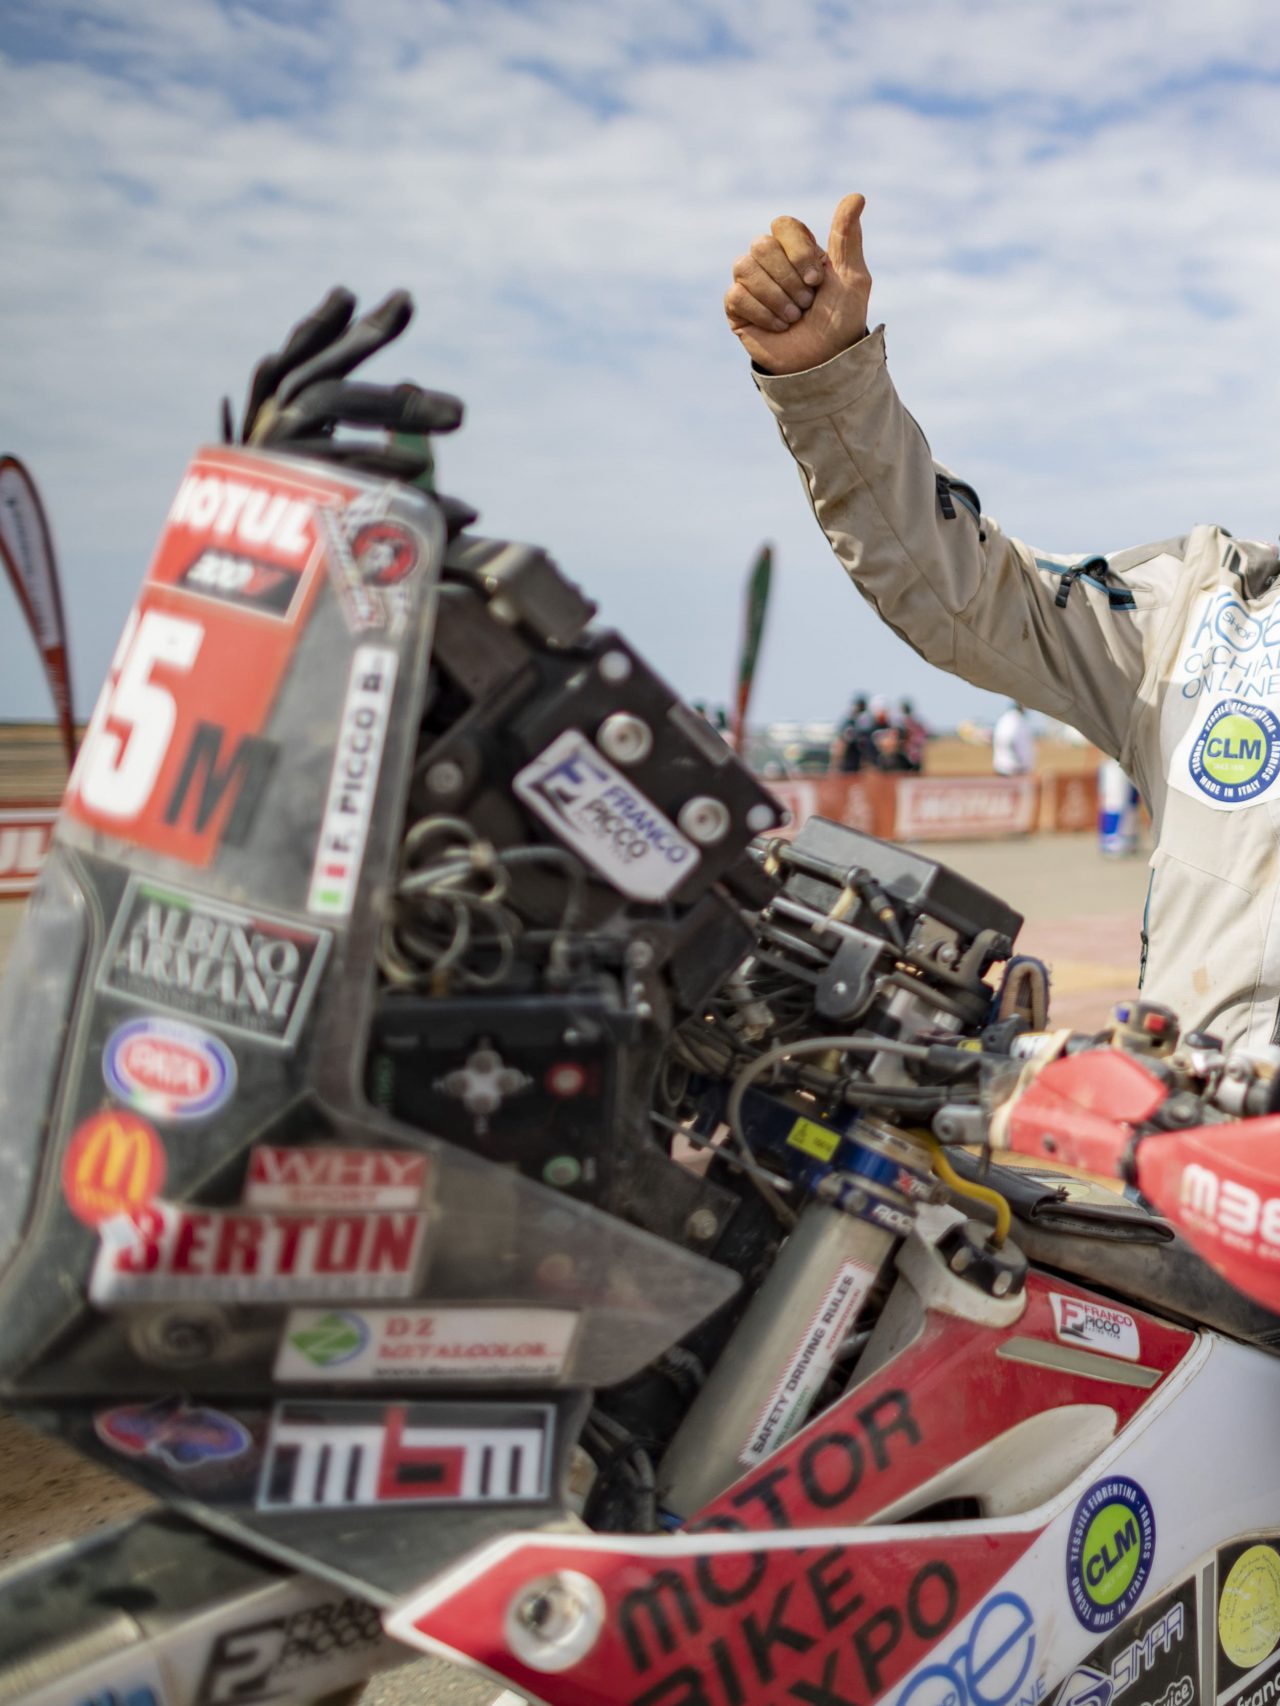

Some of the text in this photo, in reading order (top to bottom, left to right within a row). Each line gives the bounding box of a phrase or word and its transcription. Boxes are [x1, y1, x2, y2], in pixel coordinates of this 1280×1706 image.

[66, 607, 206, 823] 5
[1206, 737, 1262, 761] CLM
[339, 706, 377, 816] PICCO
[1199, 775, 1261, 798] MADE IN ITALY
[602, 785, 690, 864] FRANCO
[254, 1150, 426, 1186] WHY
[1085, 1304, 1133, 1328] FRANCO
[1085, 1314, 1121, 1335] PICCO
[752, 1275, 855, 1455] SAFETY DRIVING RULES
[619, 1387, 922, 1674] MOTOR
[1070, 1482, 1153, 1621] TECHNO TESSILE FIORENTINA FABRICS
[1086, 1517, 1138, 1587] CLM
[1093, 1567, 1146, 1626] MADE IN ITALY
